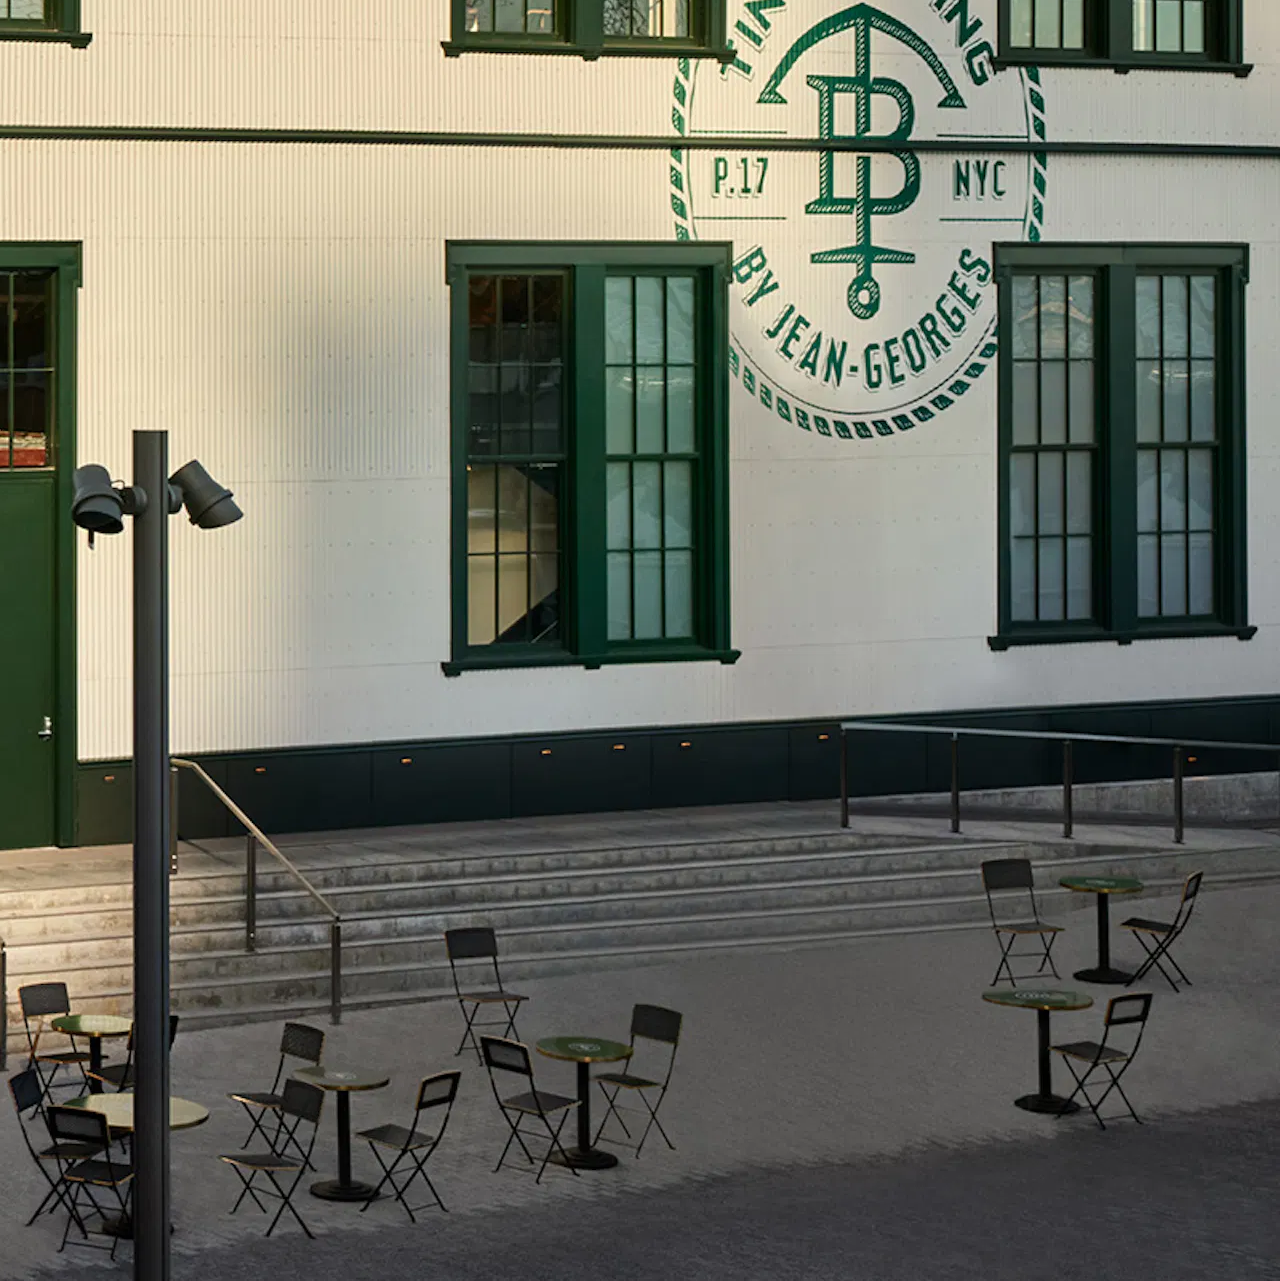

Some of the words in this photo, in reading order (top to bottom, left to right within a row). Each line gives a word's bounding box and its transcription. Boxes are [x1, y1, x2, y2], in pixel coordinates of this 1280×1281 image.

[712, 156, 769, 197] P.17
[954, 159, 1007, 200] NYC
[732, 244, 780, 308] BY
[763, 248, 992, 391] JEAN-GEORGES
